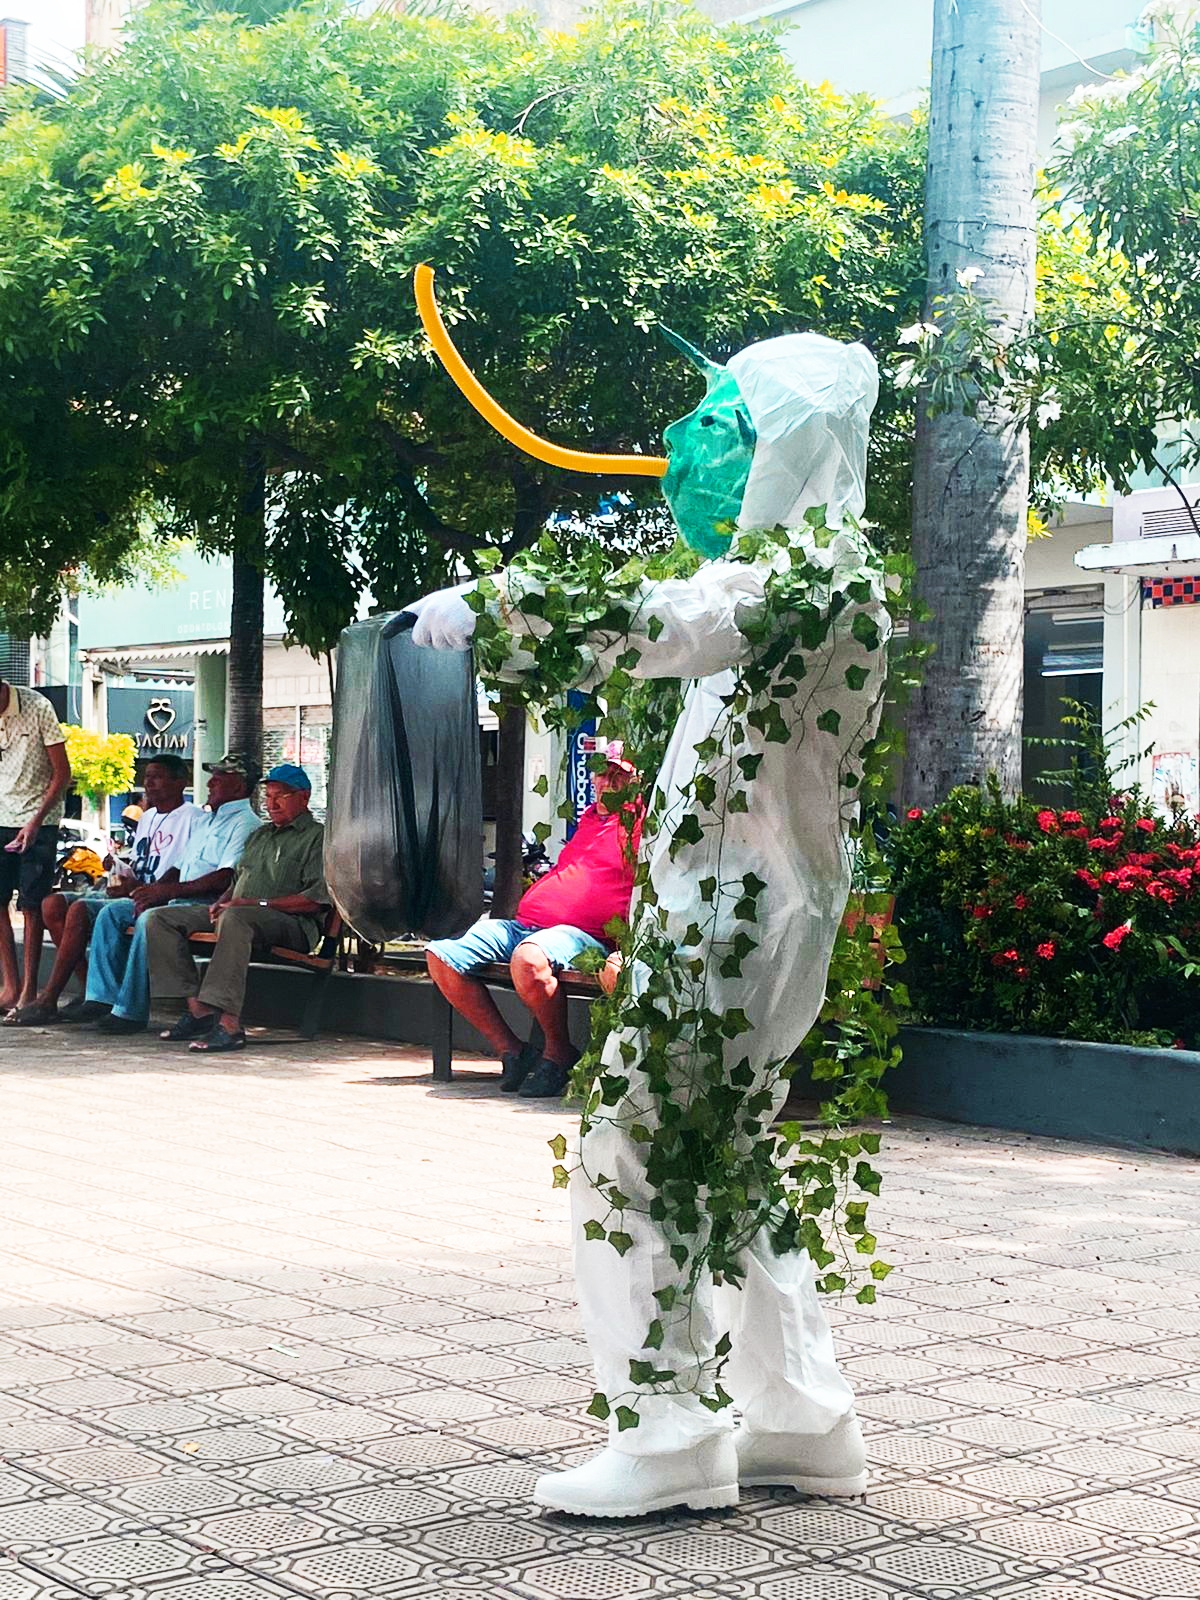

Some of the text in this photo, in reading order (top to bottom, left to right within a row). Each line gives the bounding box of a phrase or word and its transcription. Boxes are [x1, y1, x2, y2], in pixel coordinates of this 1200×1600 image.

[189, 588, 227, 611] REN
[177, 621, 231, 634] ODONTOLOG
[135, 732, 188, 749] SAGIAN
